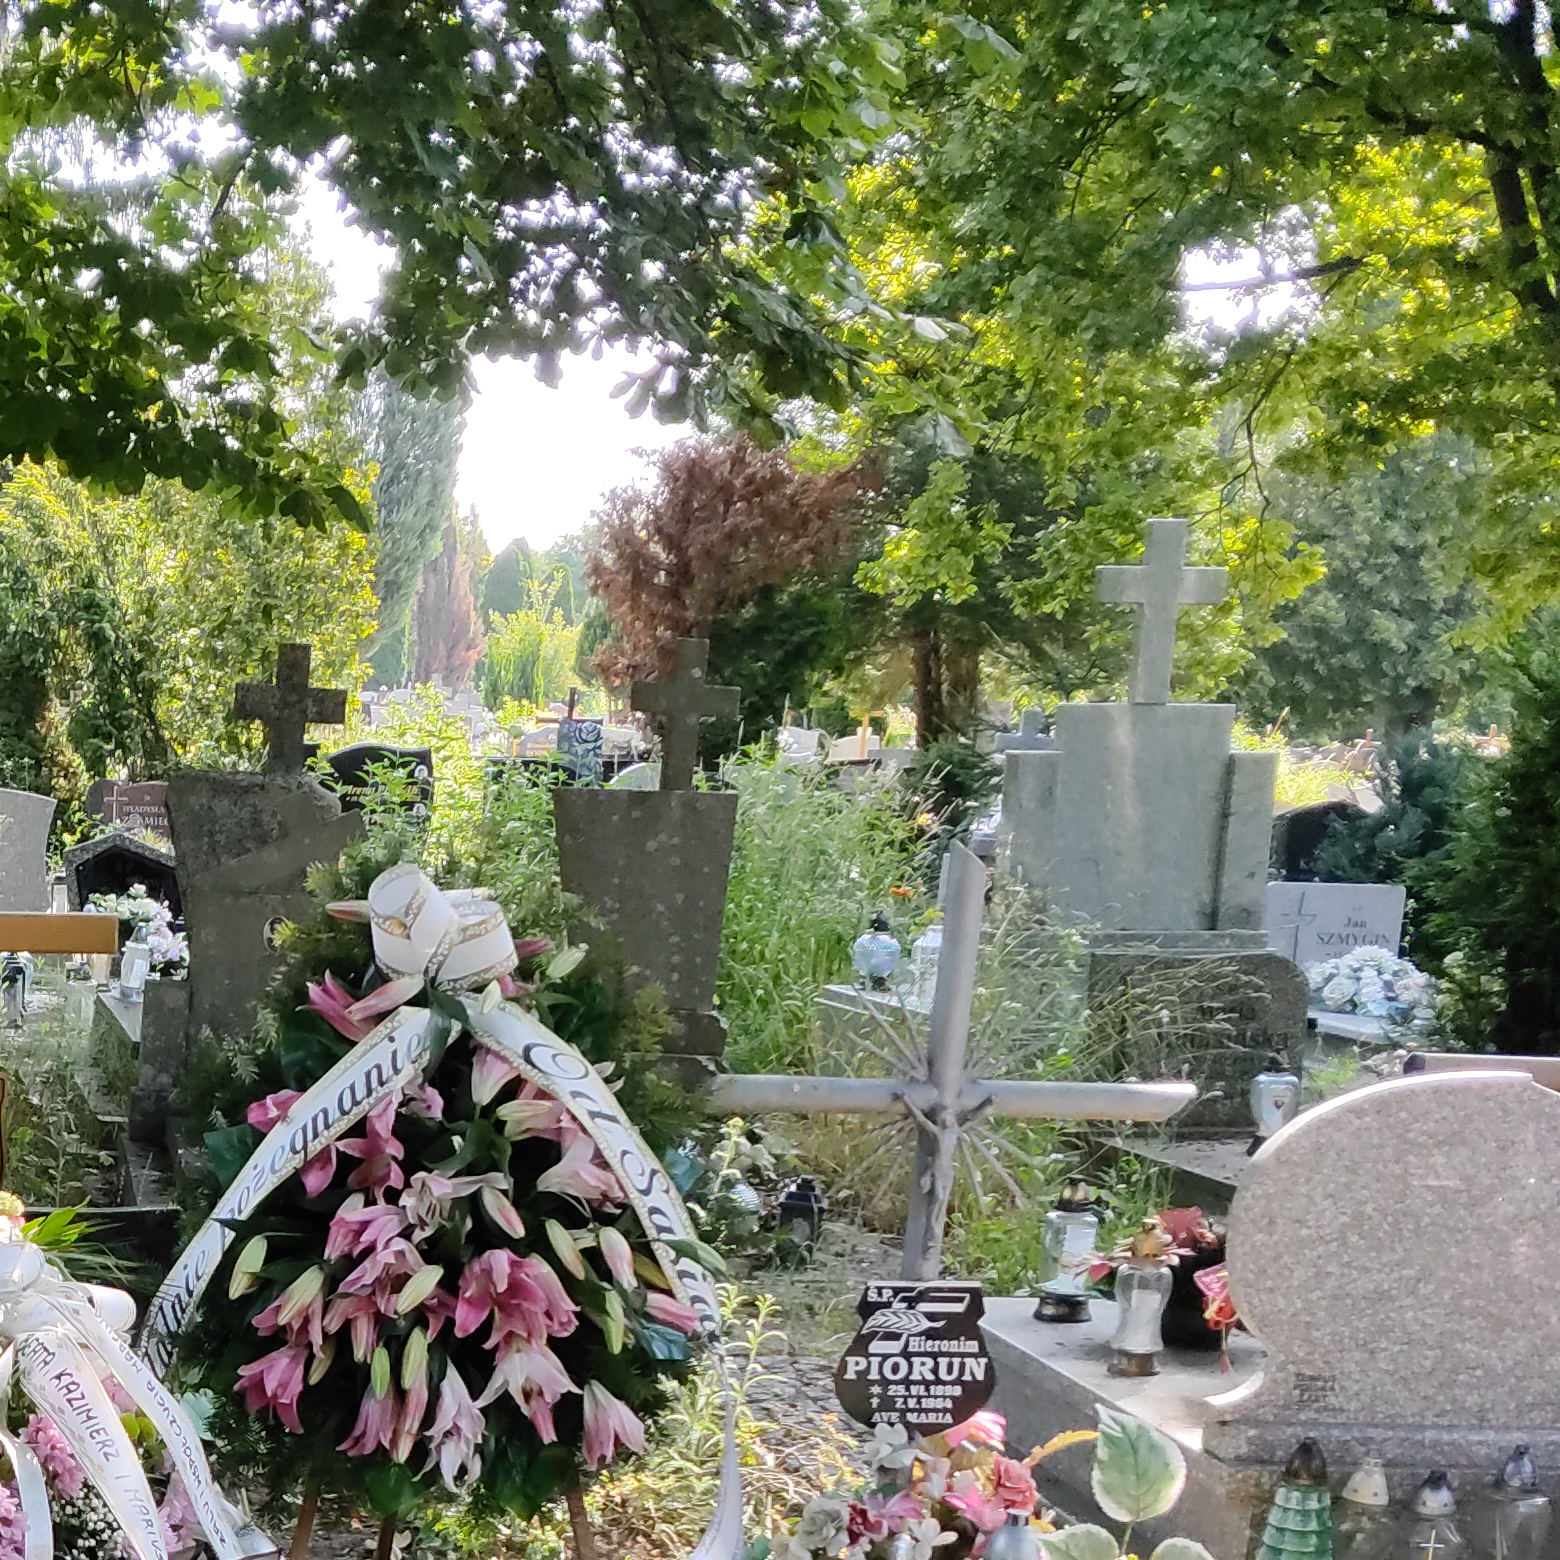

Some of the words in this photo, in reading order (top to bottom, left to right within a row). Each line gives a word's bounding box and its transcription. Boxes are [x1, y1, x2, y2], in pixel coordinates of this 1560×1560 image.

[122, 805, 167, 813] WŁADYSŁA
[1344, 917, 1368, 928] Jan
[522, 1042, 621, 1134] Od
[867, 1286, 894, 1302] Ś.P.
[907, 1336, 980, 1352] Hieronim
[843, 1356, 989, 1381] PIORUN
[49, 1368, 121, 1463] KAZIMIERZ
[870, 1412, 900, 1423] AVE
[905, 1412, 954, 1424] MARIA
